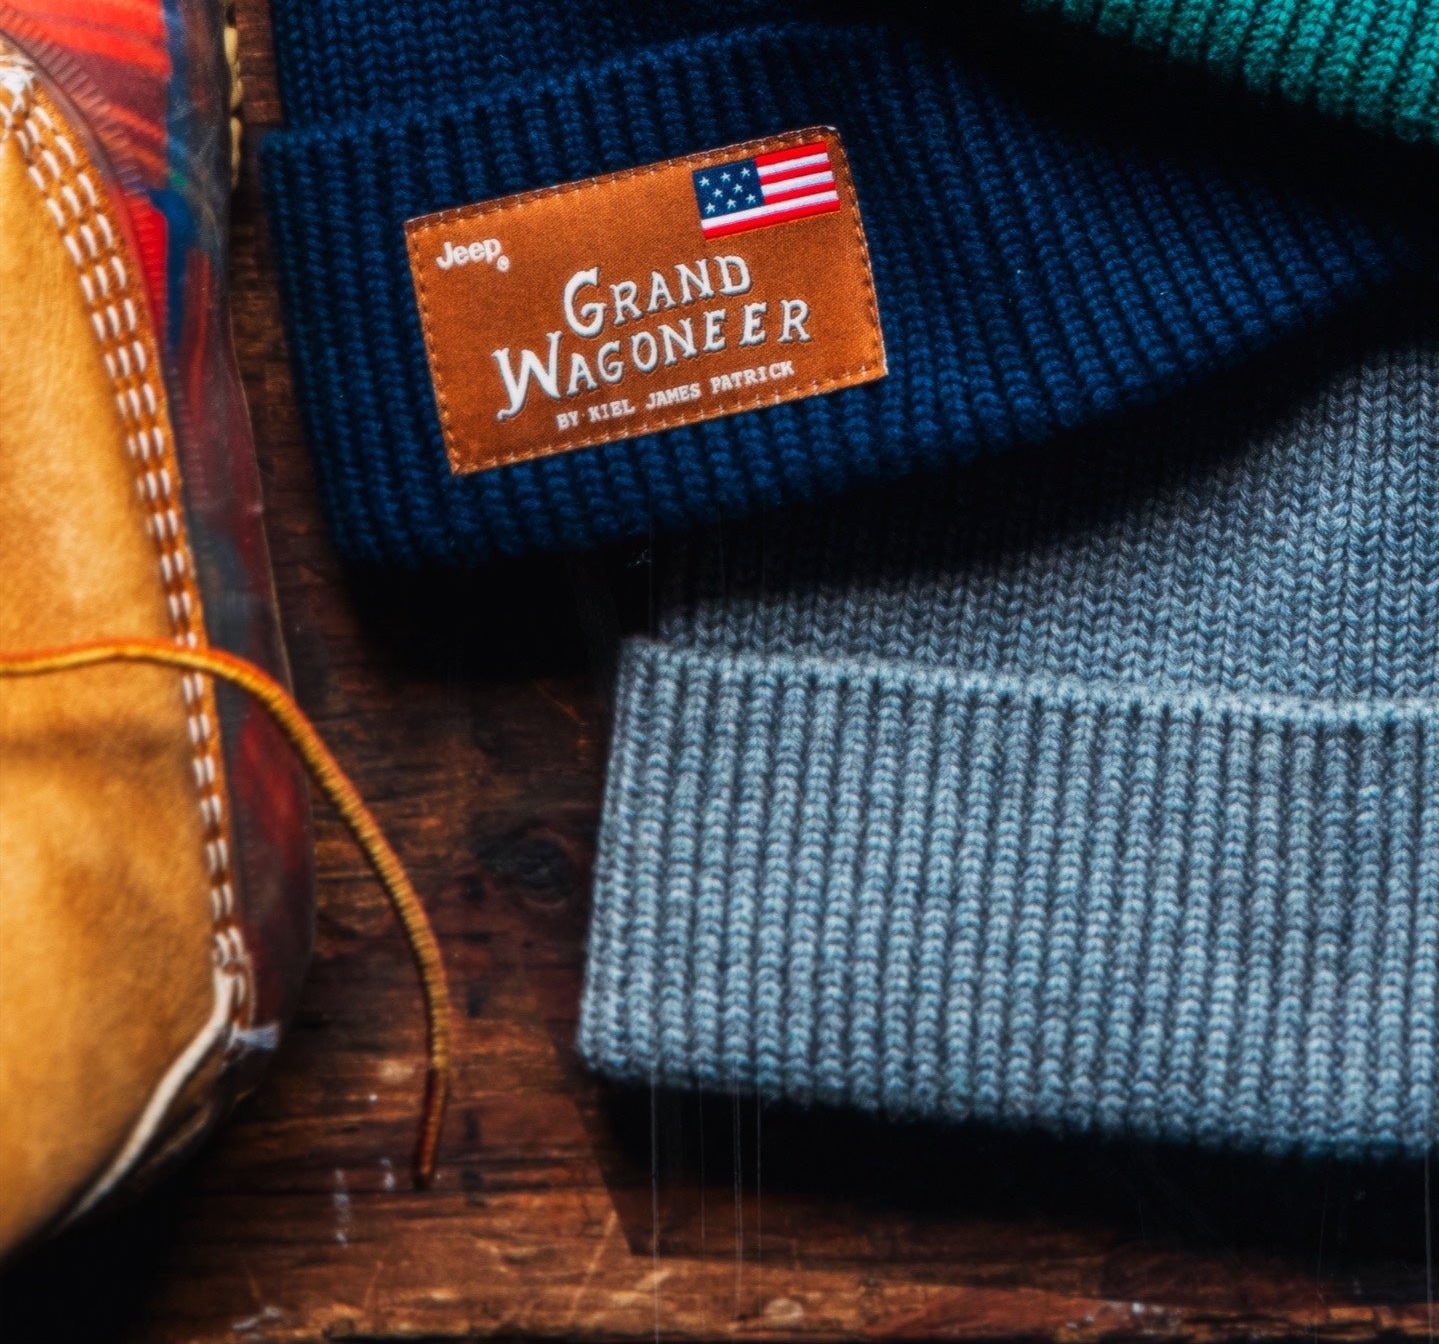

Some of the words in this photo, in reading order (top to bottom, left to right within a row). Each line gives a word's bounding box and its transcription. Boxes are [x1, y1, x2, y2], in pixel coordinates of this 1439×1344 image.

[436, 236, 509, 273] Jeep
[562, 253, 753, 338] GRAND
[491, 298, 812, 421] WAGONEER
[556, 411, 579, 432] BY
[587, 398, 636, 425] KIEL
[644, 382, 702, 412] JAMES
[710, 360, 796, 394] PATRICK
